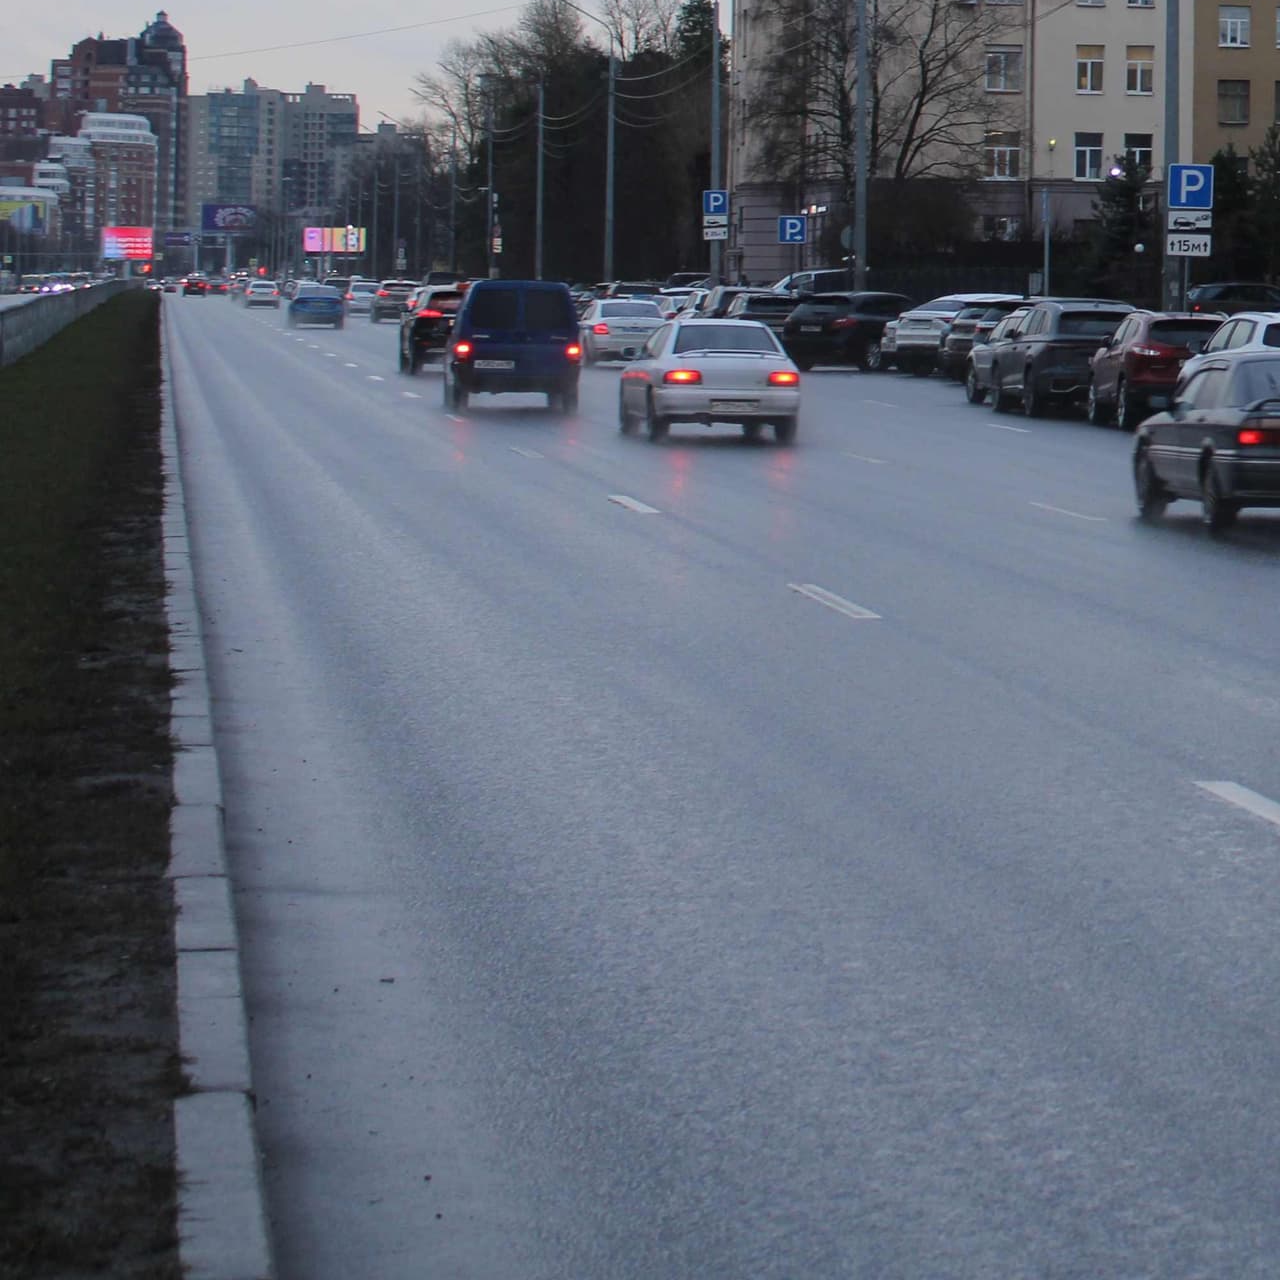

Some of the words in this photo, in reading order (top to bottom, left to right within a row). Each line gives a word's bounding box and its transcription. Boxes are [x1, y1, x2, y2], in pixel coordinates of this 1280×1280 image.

[1181, 169, 1205, 203] P
[709, 193, 724, 212] P
[785, 219, 801, 240] P
[1177, 239, 1201, 252] 15м
